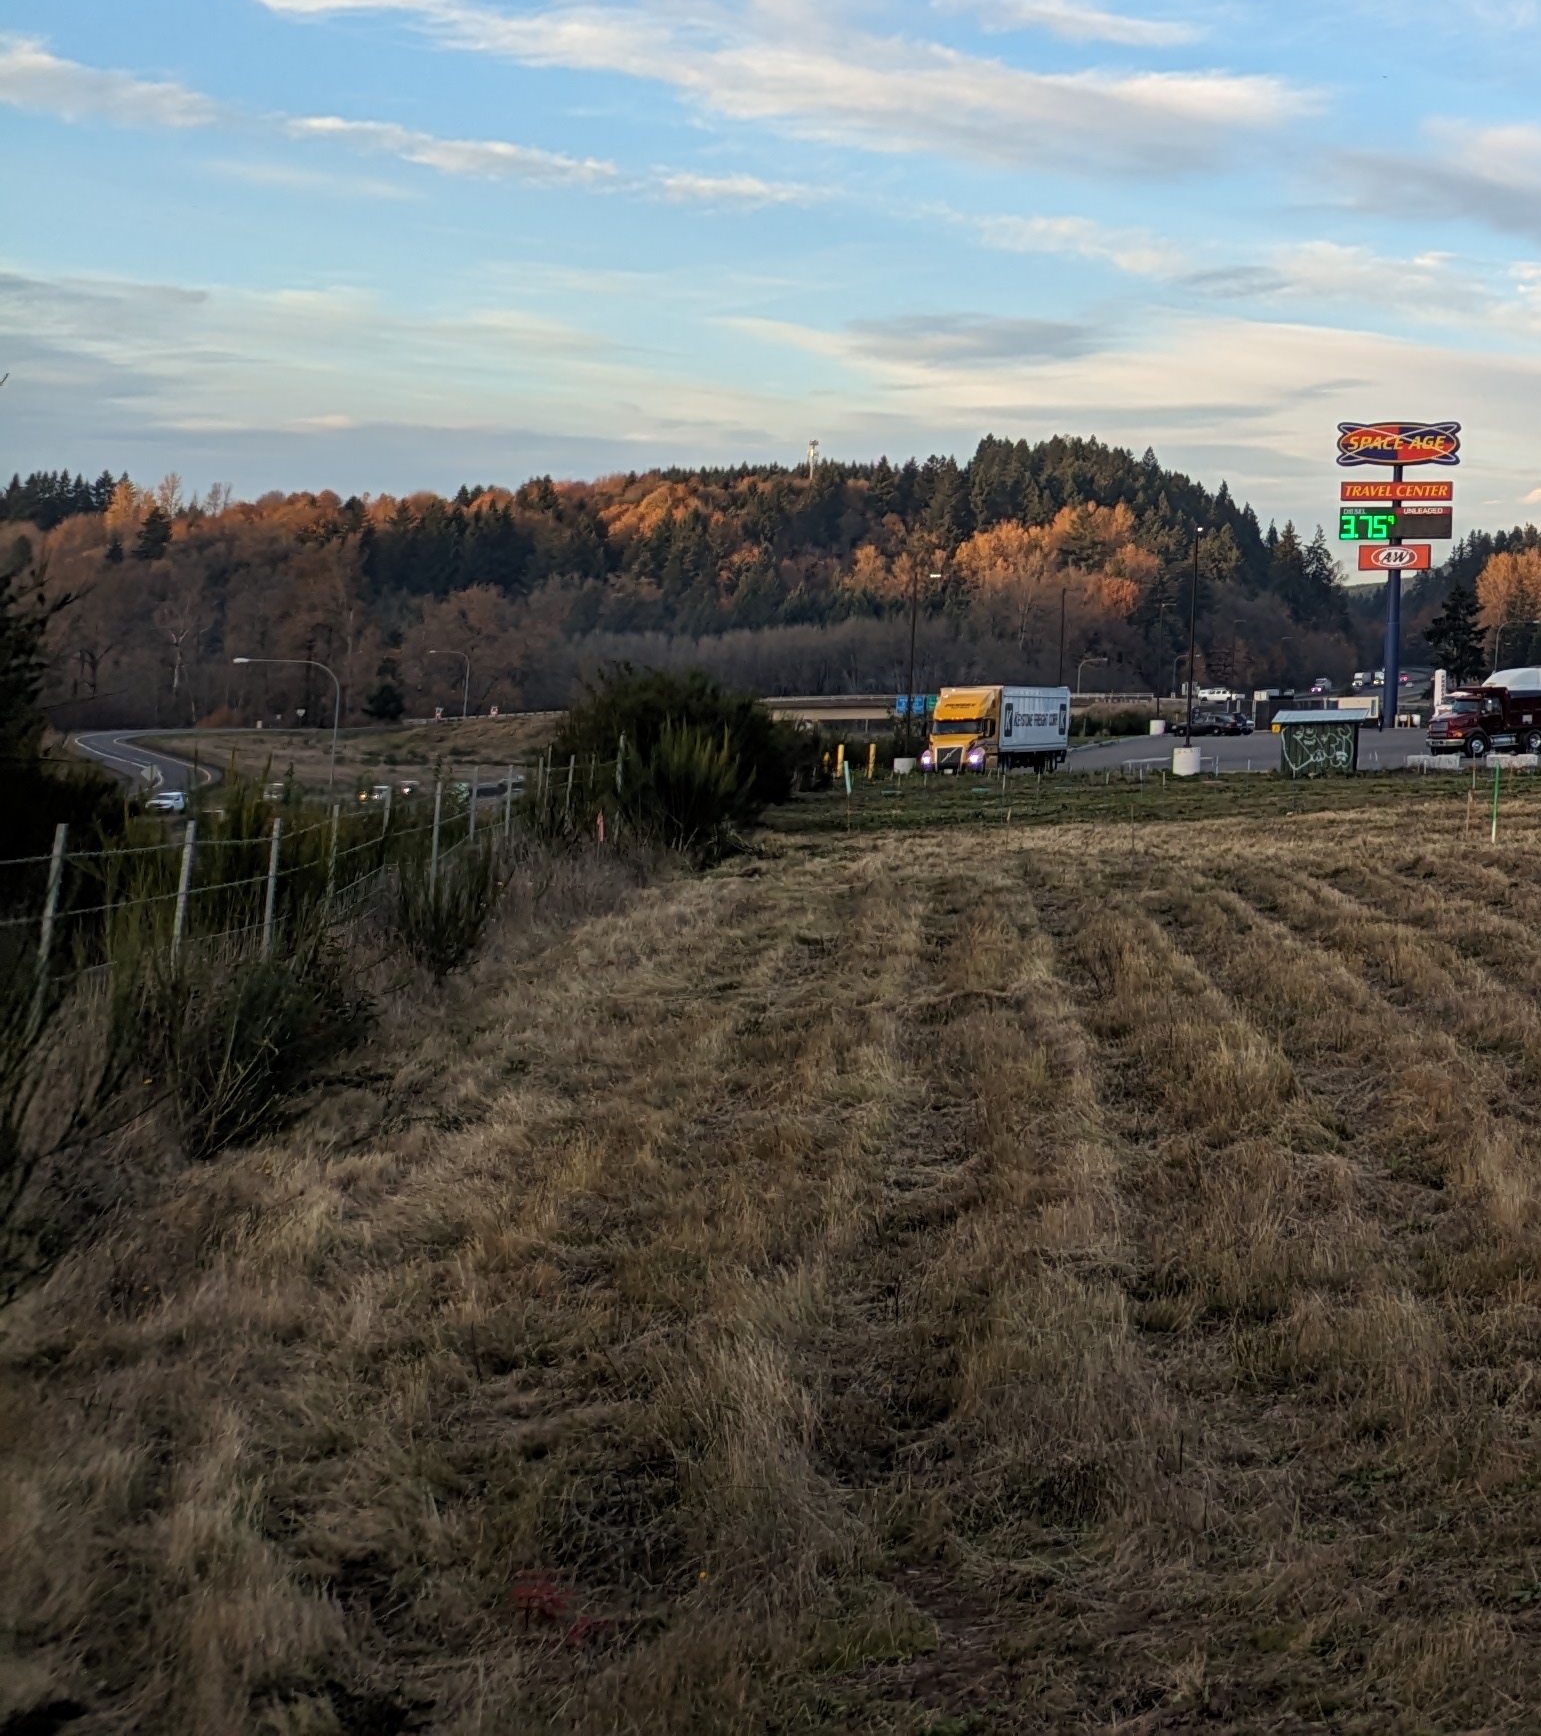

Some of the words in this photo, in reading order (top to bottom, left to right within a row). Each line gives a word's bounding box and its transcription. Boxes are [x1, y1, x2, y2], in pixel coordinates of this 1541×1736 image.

[1348, 435, 1404, 450] SPACE
[1408, 435, 1446, 450] AGE
[1345, 485, 1393, 497] TRAVEL
[1396, 485, 1448, 496] CENTER
